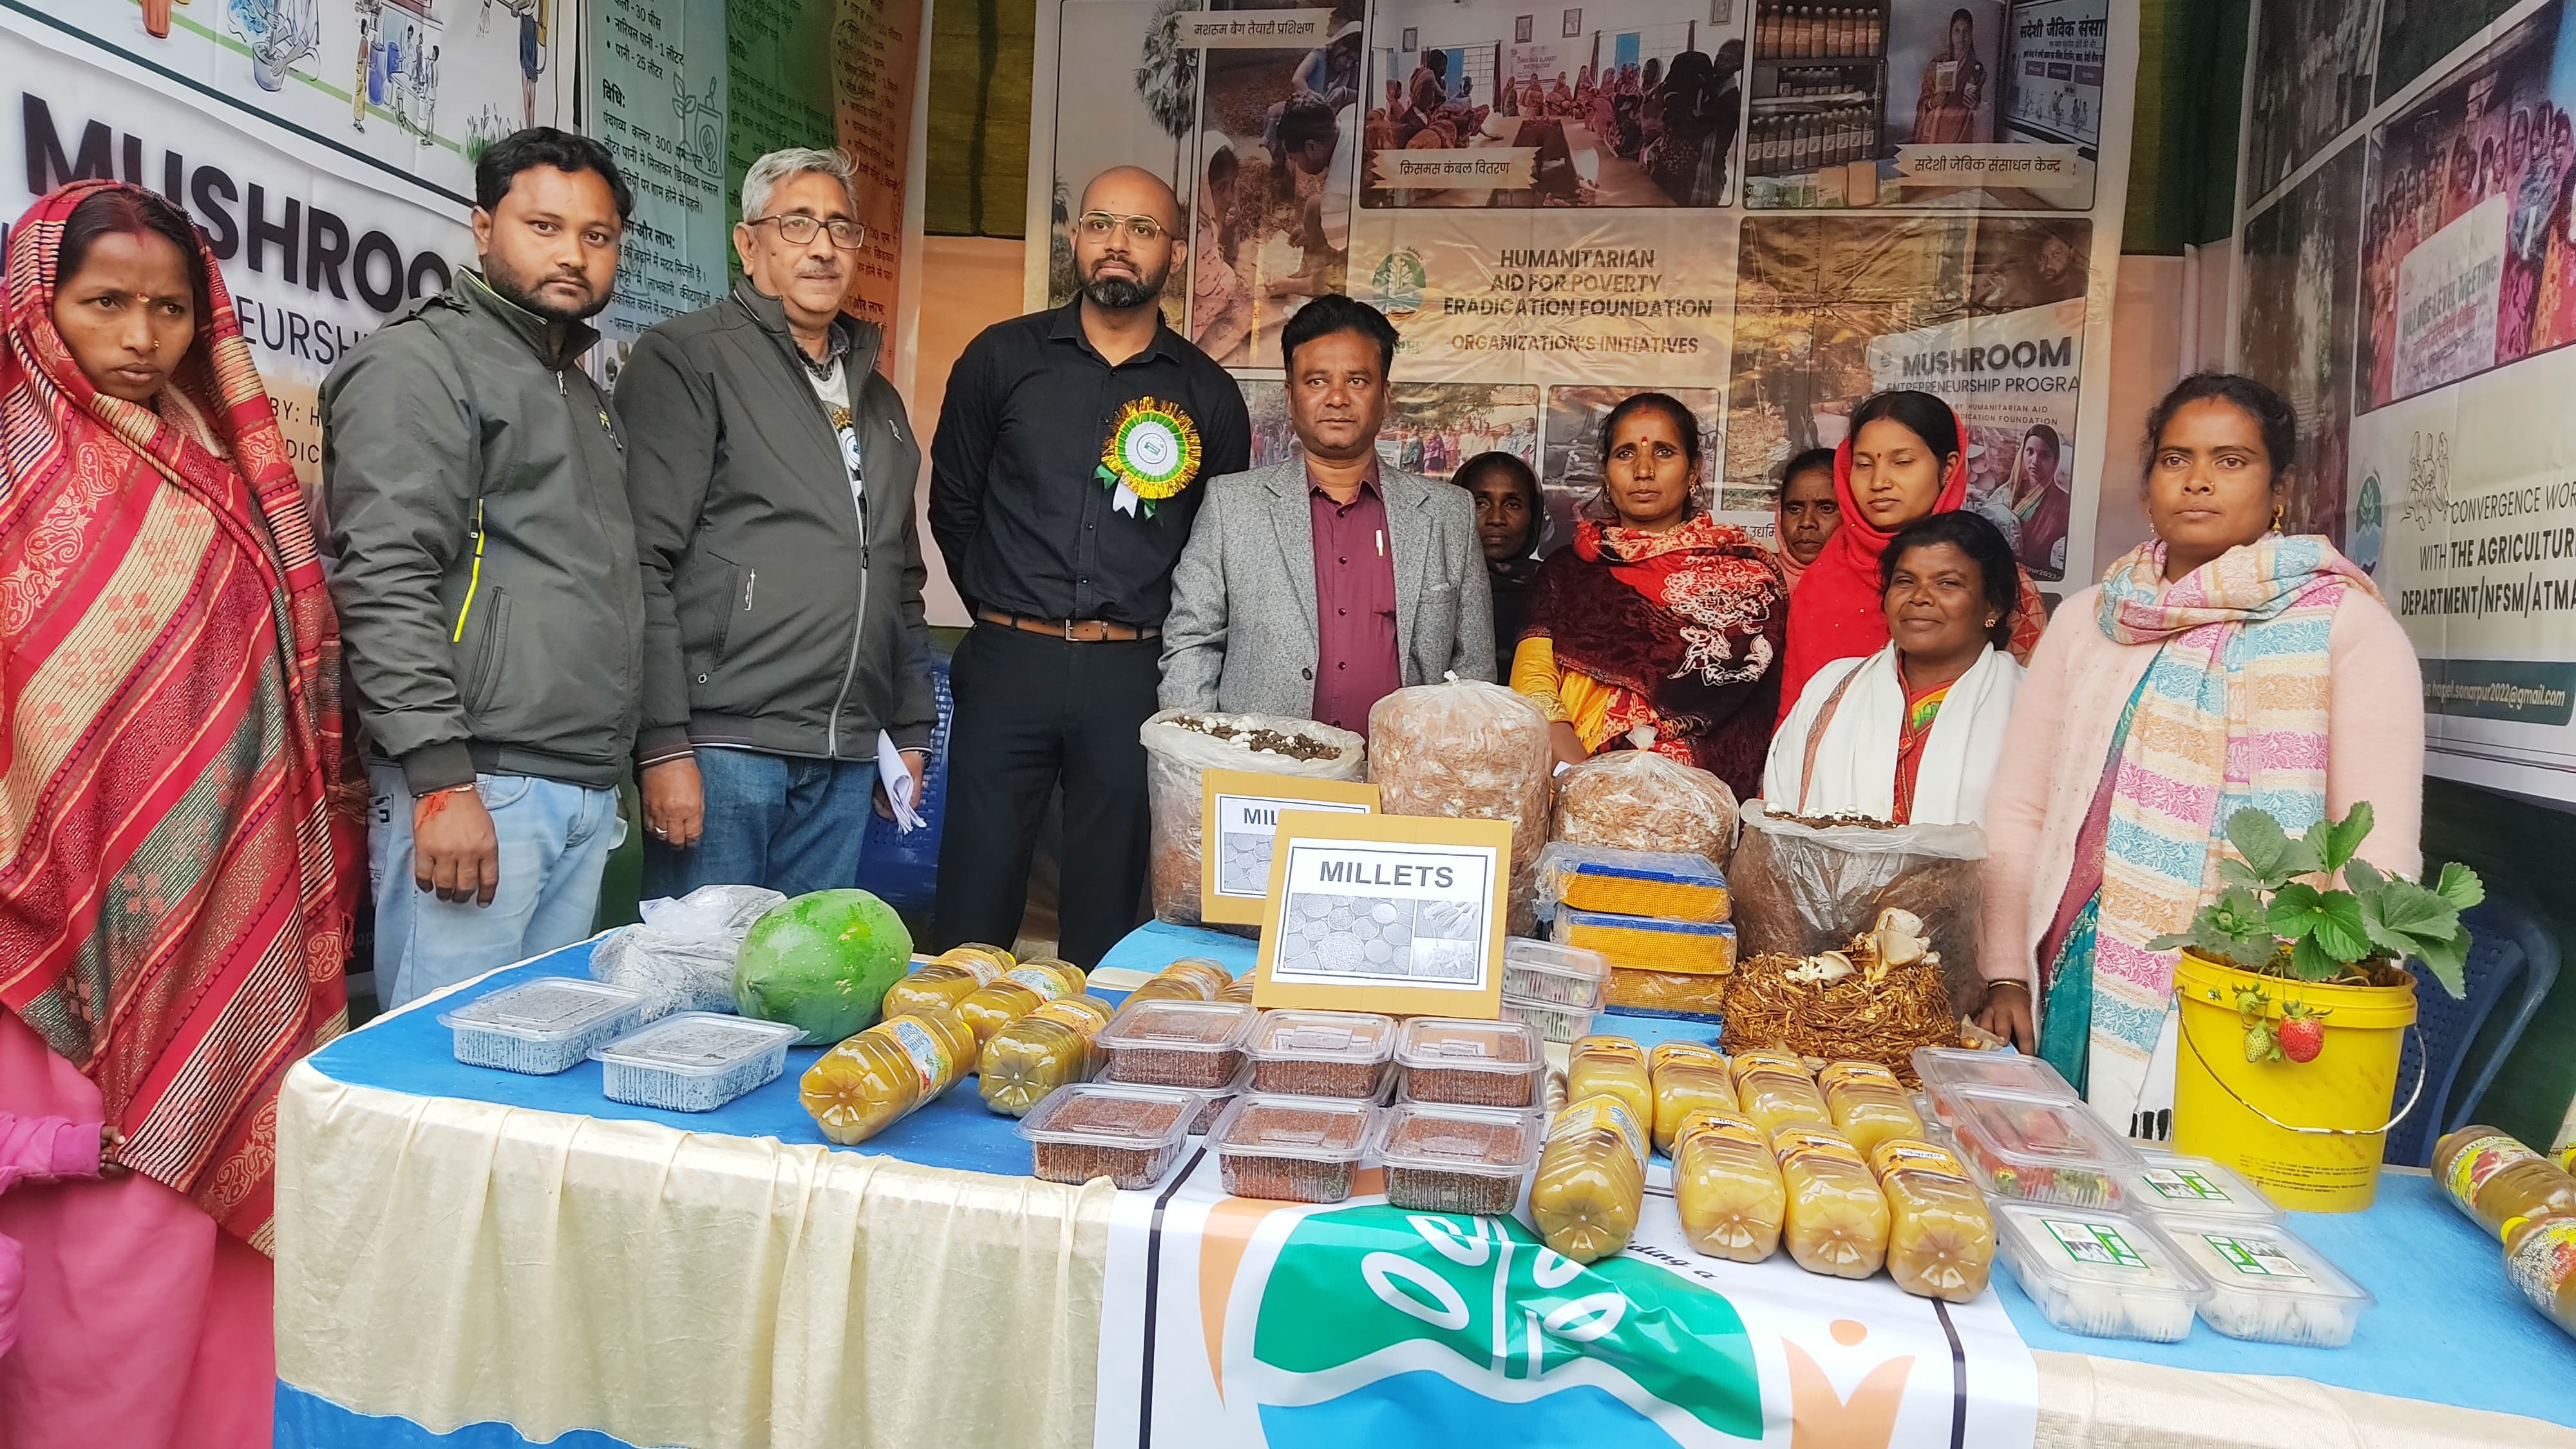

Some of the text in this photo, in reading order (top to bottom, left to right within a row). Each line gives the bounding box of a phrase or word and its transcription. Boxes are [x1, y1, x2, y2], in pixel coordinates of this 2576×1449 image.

[636, 5, 645, 22] 30
[648, 10, 661, 30] पीस
[1230, 19, 1245, 35] बैग
[1247, 19, 1276, 35] तैयारी
[1278, 19, 1315, 35] प्रशिक्षण
[614, 18, 638, 41] नारियल
[639, 33, 653, 50] पानी
[660, 43, 665, 57] 1
[666, 45, 684, 66] लीटर
[615, 44, 630, 62] पानी
[636, 54, 645, 70] 25
[647, 59, 663, 80] लीटर
[603, 79, 625, 108] विधि:
[603, 109, 627, 134] पंचगव्य
[656, 135, 672, 154] 300
[708, 159, 717, 174] 10
[604, 134, 620, 156] लीटर
[622, 146, 638, 164] पानी
[647, 153, 672, 178] मिलाकर
[701, 180, 719, 196] फसल
[1400, 158, 1511, 175] क्रिसमस कंबल वितरण
[1914, 155, 2062, 173] सदेशी जेबिक संसाधन केन्द्र
[620, 167, 639, 189] त्तियों
[641, 178, 650, 193] पर
[665, 185, 676, 204] होने
[679, 191, 684, 207] से
[23, 91, 452, 312] MUSHROO
[636, 220, 653, 243] और
[660, 258, 674, 274] मदद
[675, 259, 694, 279] मिलती
[1500, 249, 1655, 268] HUMANITARIAN
[647, 278, 674, 296] लाभकारी
[1490, 274, 1662, 292] AID FOR POVERTY
[637, 298, 652, 314] करने
[660, 306, 674, 318] मदद
[1443, 297, 1713, 317] ERADICATION FOUNDATION
[614, 317, 634, 333] फसल
[1600, 336, 1698, 354] INITIATIVES
[1902, 336, 2072, 377] MUSHROOM
[310, 407, 320, 427] H
[1960, 413, 2058, 426] DICATION FOUNDATION
[1968, 404, 2028, 413] HUMANITARIAN
[286, 439, 320, 464] DIC
[2451, 481, 2576, 524] CONVERGENCE WOR
[2420, 527, 2576, 571] WITH THE AGRICULTUR
[1320, 861, 1454, 888] MILLETS
[1627, 1240, 1692, 1267] ding
